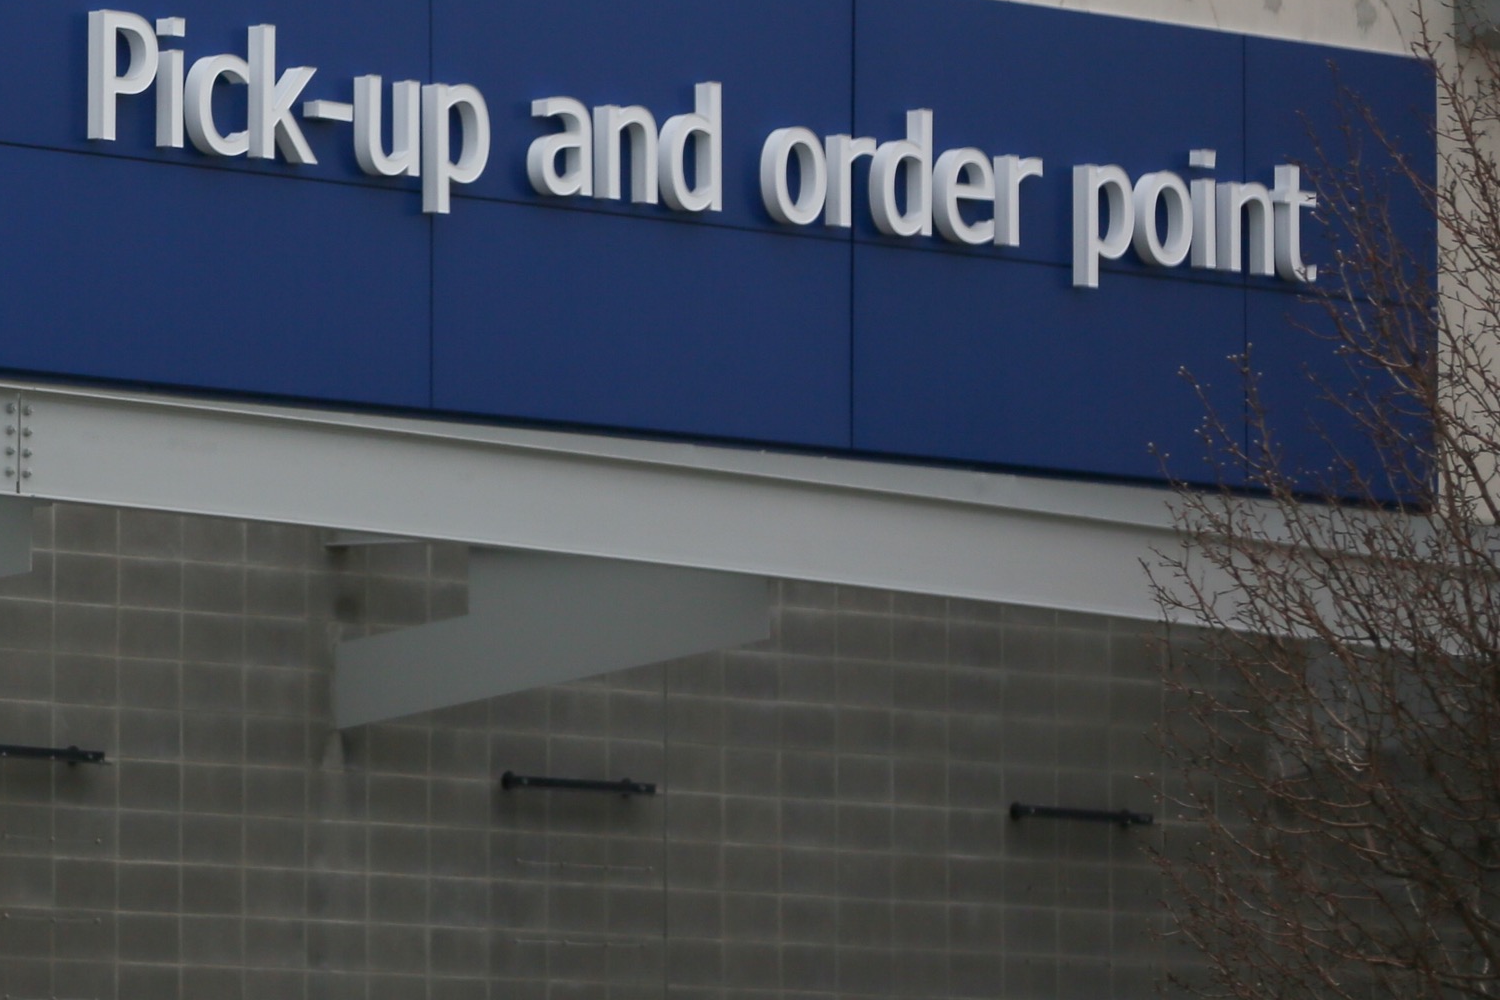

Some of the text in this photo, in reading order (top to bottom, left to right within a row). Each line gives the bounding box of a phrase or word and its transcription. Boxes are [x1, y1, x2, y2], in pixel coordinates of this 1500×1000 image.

[87, 9, 1317, 287] Pick-up and order point
